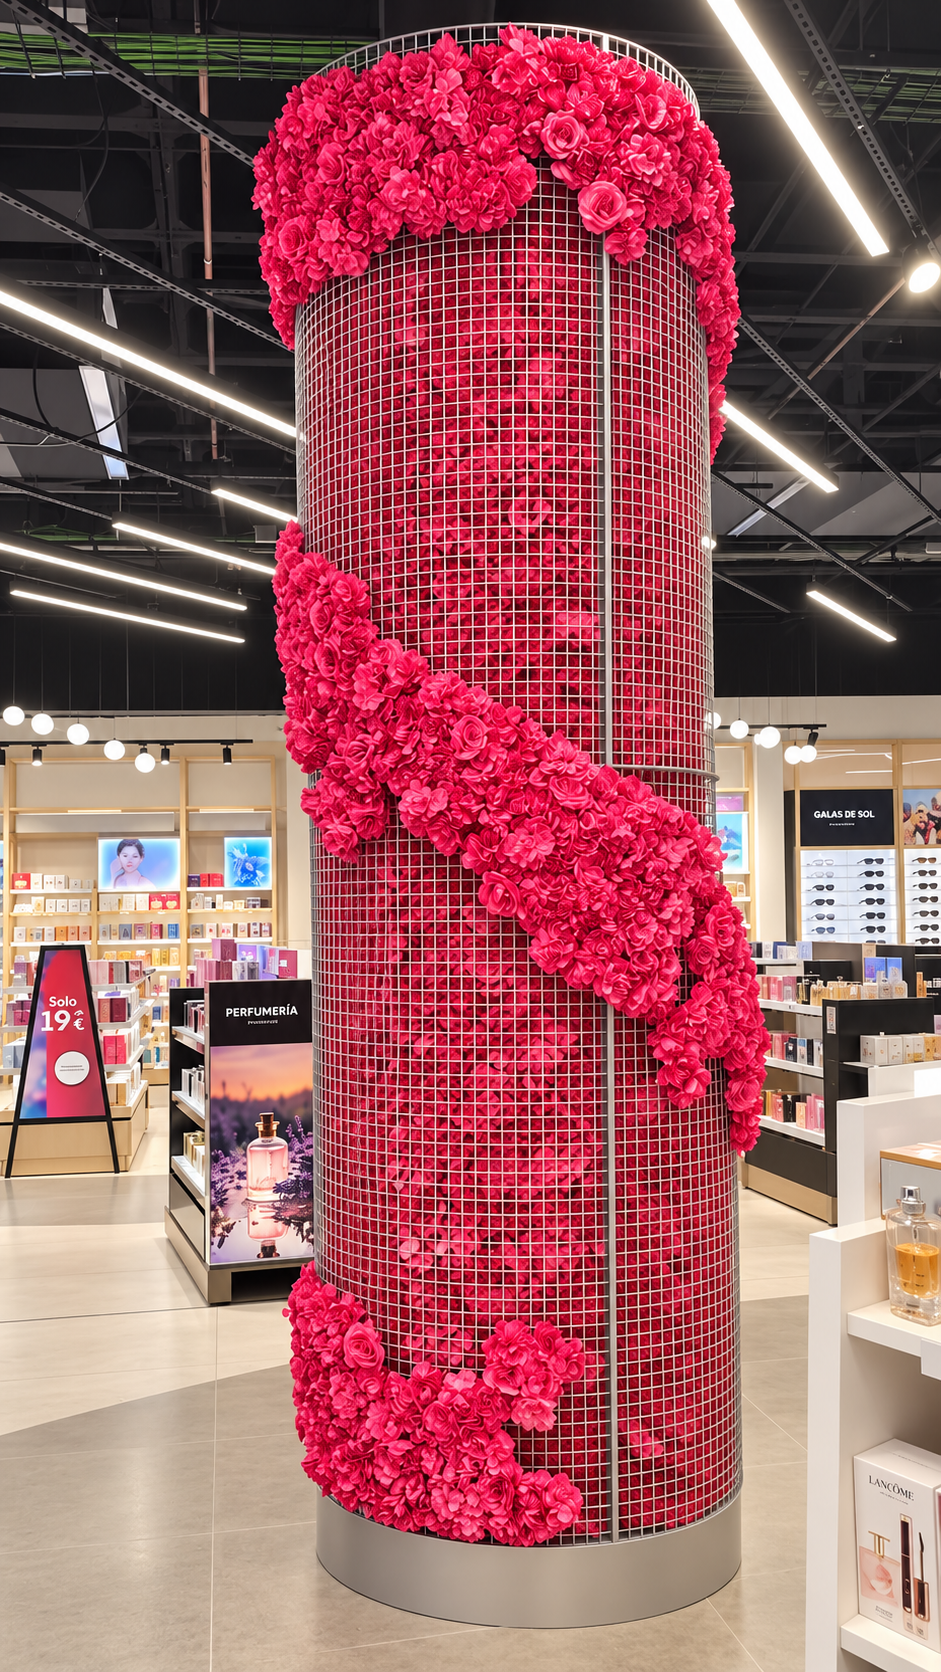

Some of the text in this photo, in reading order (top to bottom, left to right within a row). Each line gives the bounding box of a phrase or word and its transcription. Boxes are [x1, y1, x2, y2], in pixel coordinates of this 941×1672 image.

[813, 810, 875, 819] GALAS DE SOL
[48, 995, 77, 1007] Solo
[225, 1003, 299, 1017] PERFUMERÍA
[868, 1475, 915, 1501] LANCÔME
